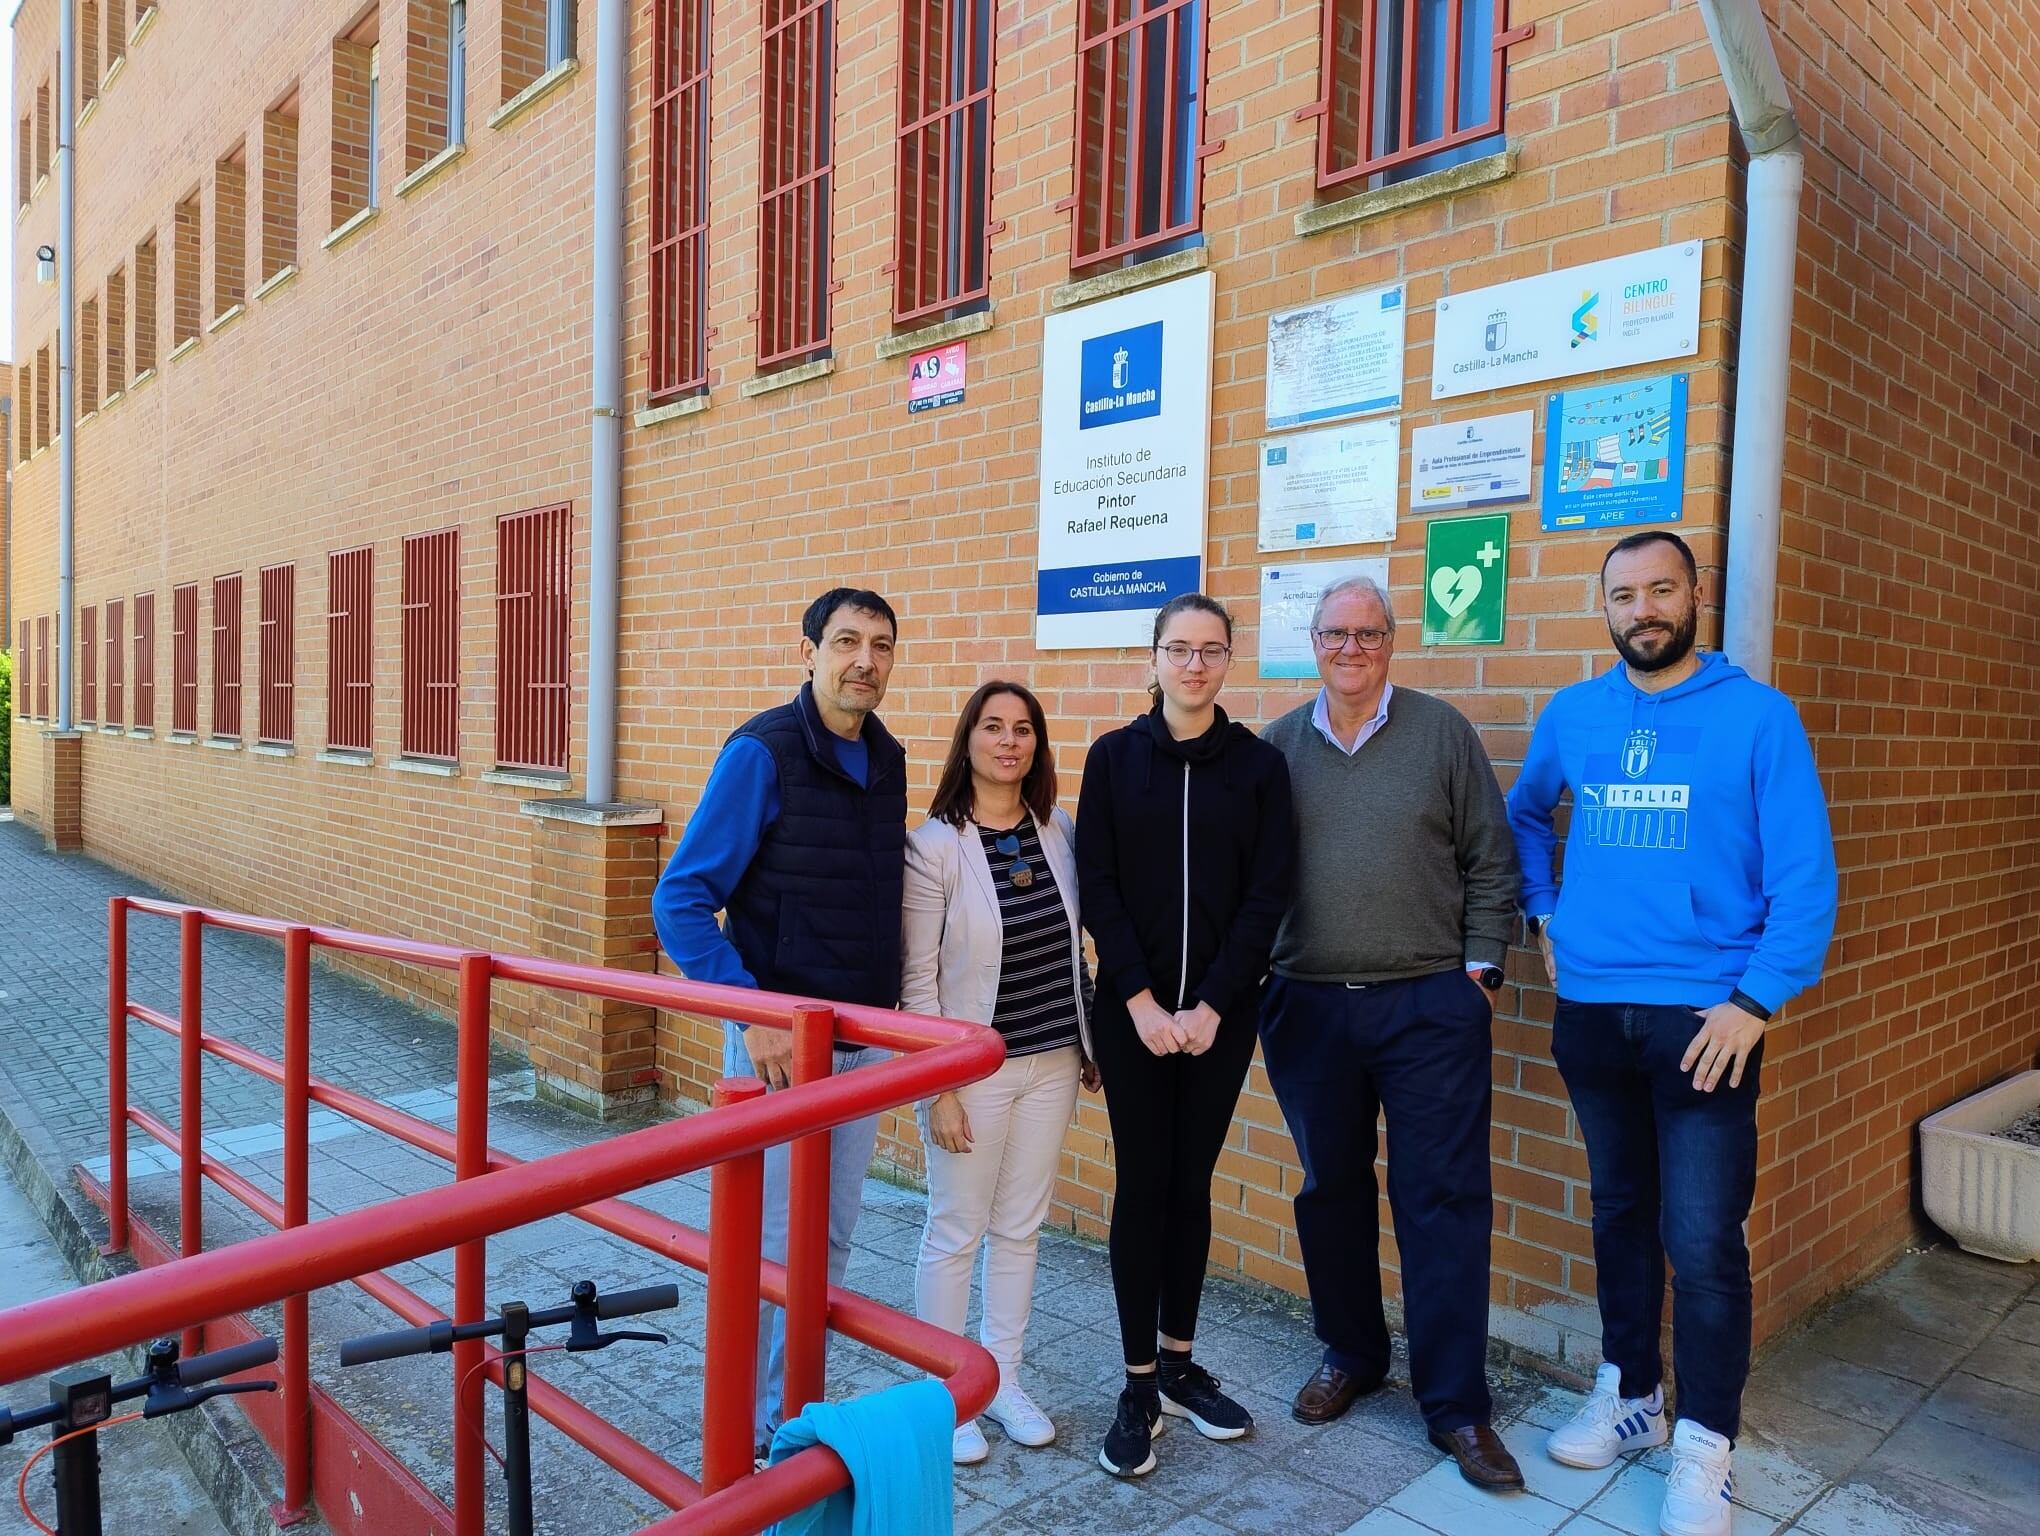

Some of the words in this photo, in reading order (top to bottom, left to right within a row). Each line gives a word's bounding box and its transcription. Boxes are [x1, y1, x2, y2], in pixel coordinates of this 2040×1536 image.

[1624, 278, 1668, 299] CENTRO
[1453, 356, 1501, 374] Castilla-La
[1503, 350, 1539, 363] Mancha
[1085, 394, 1125, 414] Castilla-La
[1125, 388, 1157, 406] Mancha
[1086, 452, 1132, 470] Instituto
[1135, 448, 1151, 462] de
[1054, 474, 1113, 495] Educación
[1117, 464, 1187, 486] Secundaria
[1097, 494, 1136, 510] Pintor
[1067, 517, 1106, 534] Rafael
[1110, 512, 1168, 531] Requena
[1599, 510, 1625, 521] APEE
[1093, 571, 1130, 583] Gobierno
[1131, 569, 1143, 580] de
[1070, 584, 1125, 598] CASTILLA-LA
[1126, 581, 1167, 595] MANCHA
[1283, 591, 1319, 600] Acreditaci
[1612, 789, 1682, 803] ITALIA
[1581, 807, 1688, 850] PUMA
[1689, 1433, 1718, 1449] adidas
